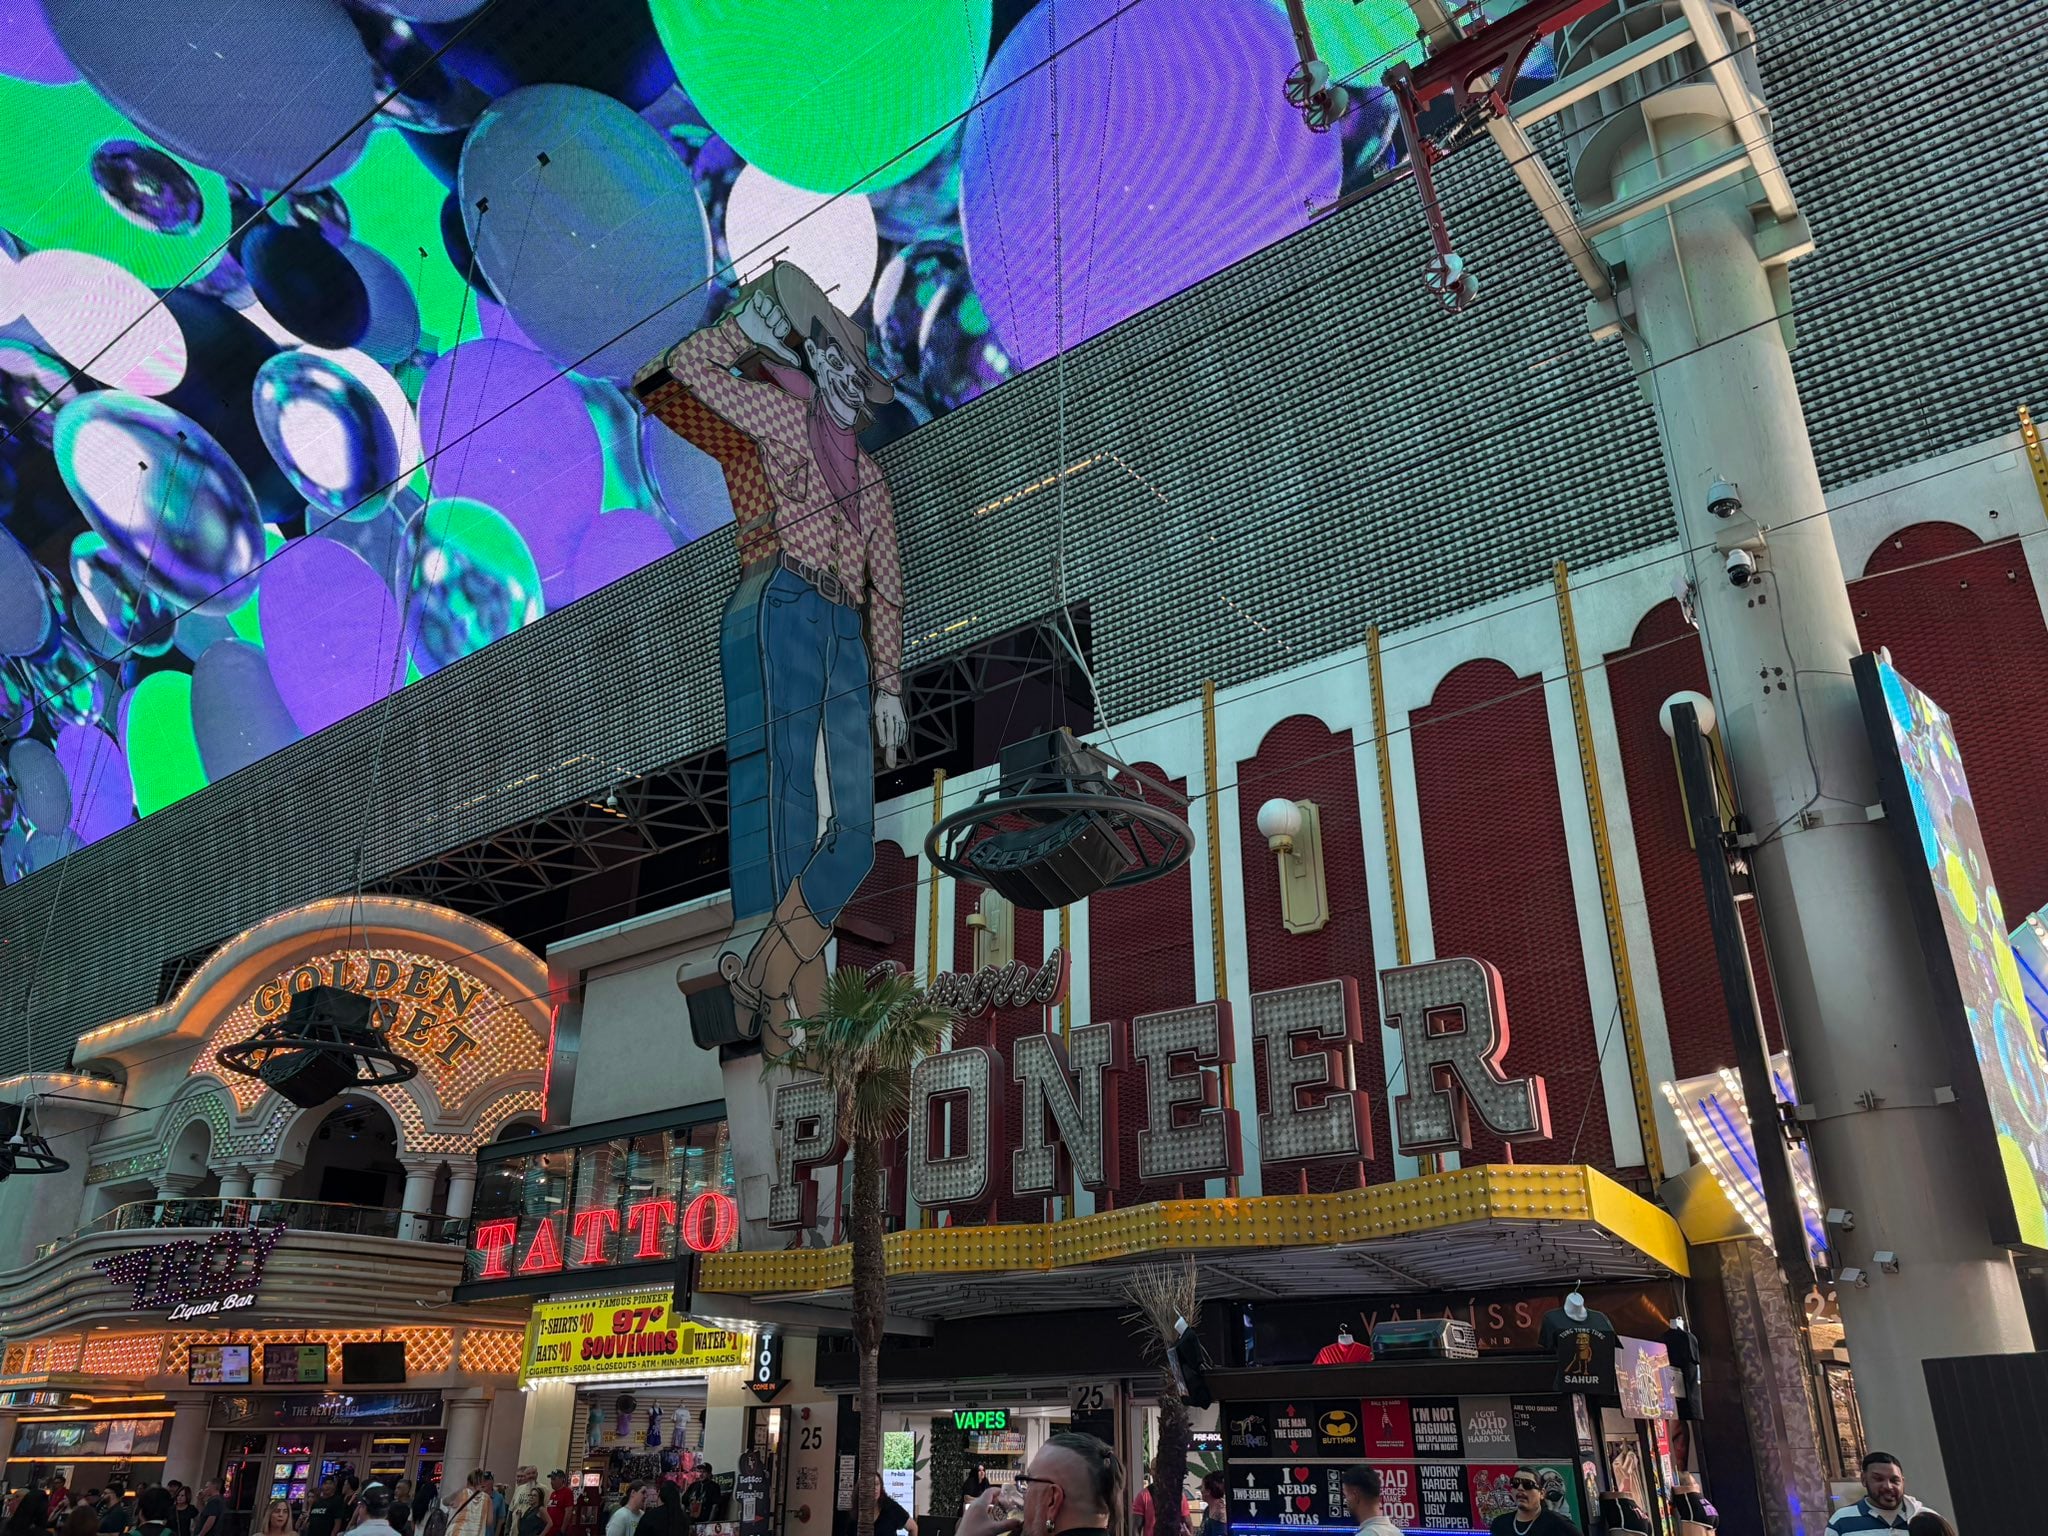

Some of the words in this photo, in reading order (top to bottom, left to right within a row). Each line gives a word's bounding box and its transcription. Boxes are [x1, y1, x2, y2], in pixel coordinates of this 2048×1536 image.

[252, 957, 482, 1018] GOLDEN
[865, 946, 1063, 1018] mous
[92, 1222, 287, 1311] TROY
[168, 1300, 220, 1320] Liquor
[220, 1293, 255, 1310] Bar
[599, 1296, 632, 1308] FAMOUS
[633, 1293, 669, 1306] PIONEER
[540, 1315, 579, 1335] T-SHIRTS
[580, 1312, 594, 1333] $10
[1559, 1327, 1574, 1339] TUNG
[1591, 1328, 1606, 1340] TUNG
[581, 1329, 679, 1361] SOUVENIRS
[694, 1331, 727, 1351] WATER
[727, 1331, 738, 1351] $1
[535, 1344, 559, 1362] HATS
[559, 1341, 572, 1362] $10
[529, 1365, 569, 1376] CIGARETTES
[573, 1364, 591, 1373] SODA
[596, 1360, 637, 1371] CLOSEOUTS
[641, 1359, 657, 1368] ATM
[661, 1356, 700, 1367] MINI-MART
[705, 1354, 736, 1363] SNACKS
[1564, 1375, 1599, 1384] SAHUR
[1077, 1385, 1104, 1409] 25
[292, 1406, 309, 1416] THE
[310, 1405, 333, 1416] NEXT
[1412, 1407, 1430, 1421] I'M
[1431, 1407, 1455, 1421] NOT
[1480, 1410, 1496, 1418] GOT
[954, 1411, 1006, 1429] VAPES
[1278, 1418, 1290, 1427] THE
[1291, 1418, 1307, 1427] MAN
[1468, 1417, 1508, 1429] ADHD
[1274, 1429, 1287, 1438] THE
[1287, 1429, 1312, 1438] LEGEND
[1414, 1422, 1457, 1434] ARGUING
[801, 1427, 822, 1450] 25
[1282, 1467, 1292, 1484] I
[1420, 1465, 1461, 1477] WORKIN'
[1277, 1484, 1317, 1494] NERDS
[1421, 1478, 1458, 1490] HARDER
[1233, 1489, 1270, 1500] TWO-SEATER
[1422, 1491, 1447, 1502] THAN
[1449, 1491, 1464, 1503] AN
[1284, 1496, 1293, 1513] I
[1379, 1502, 1415, 1519] OOD
[1424, 1504, 1446, 1516] UGLY
[1279, 1513, 1319, 1525] TORTAS
[1425, 1516, 1470, 1529] STRIPPER
